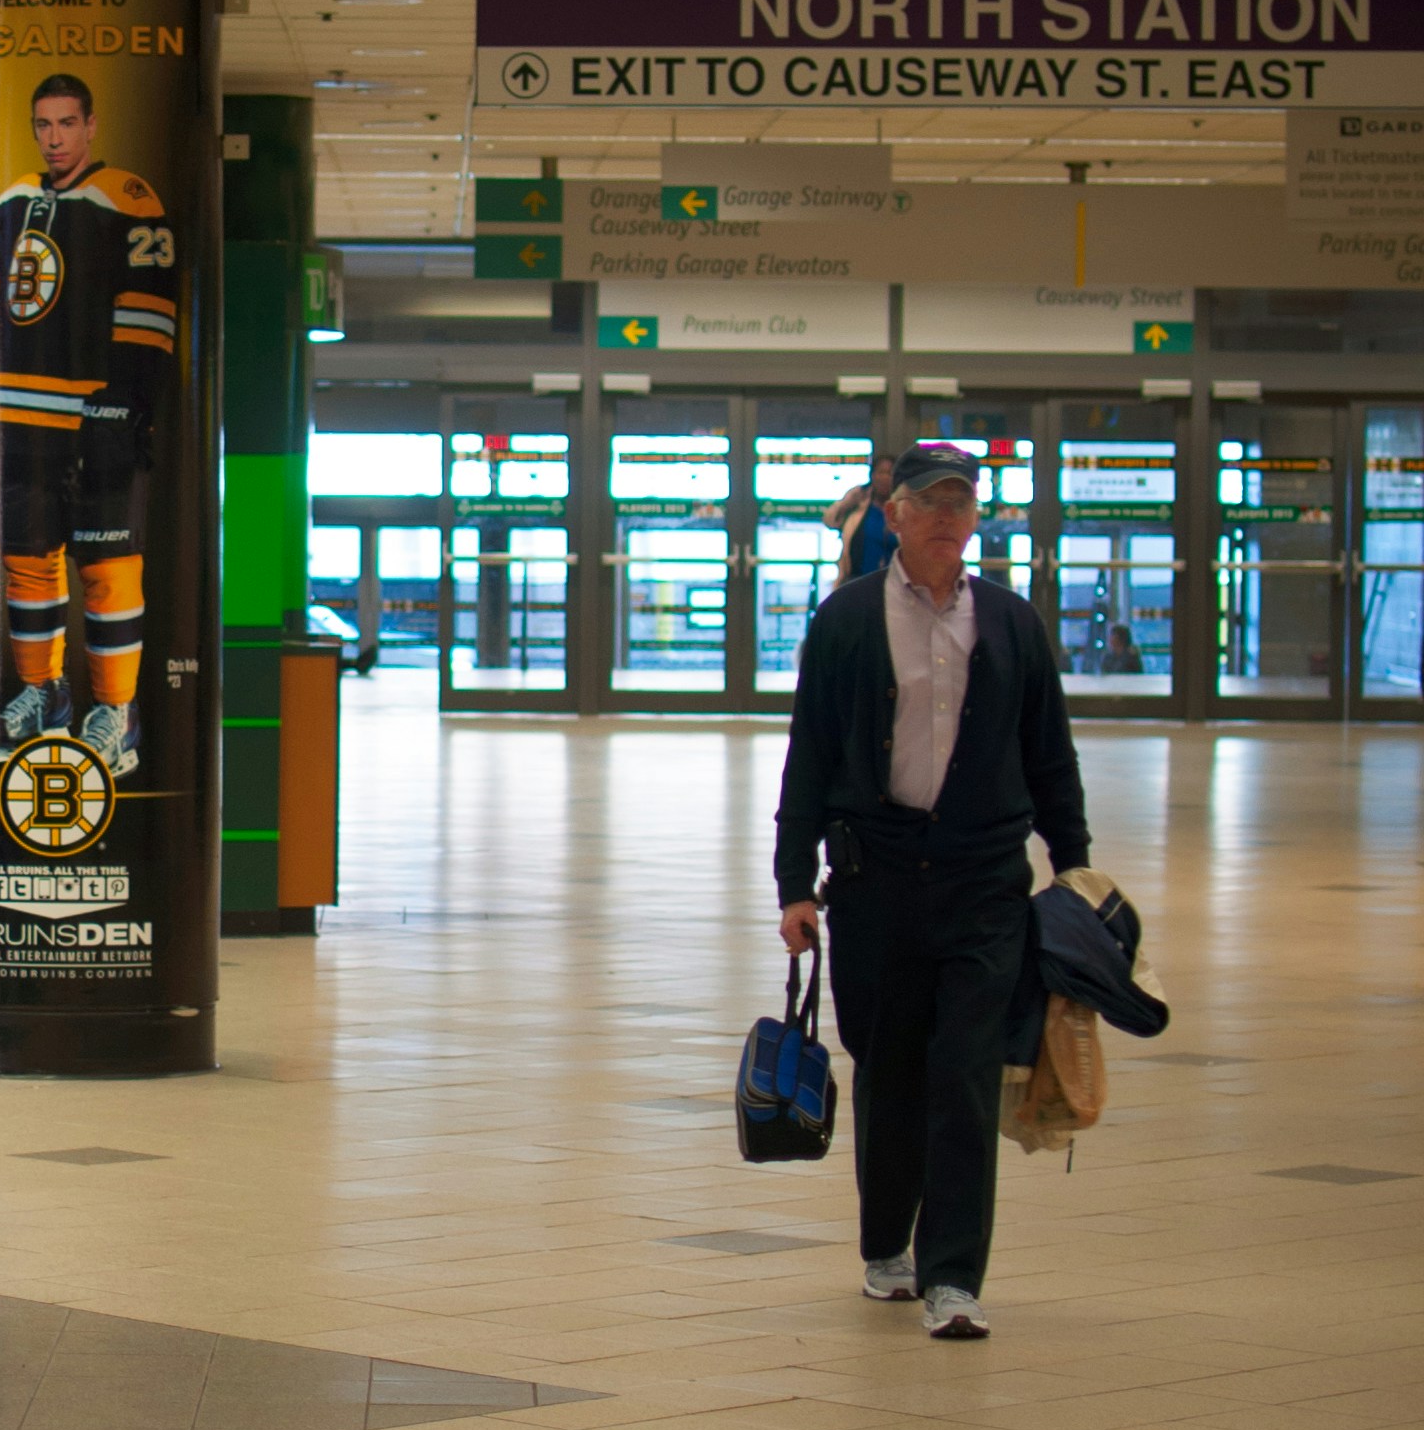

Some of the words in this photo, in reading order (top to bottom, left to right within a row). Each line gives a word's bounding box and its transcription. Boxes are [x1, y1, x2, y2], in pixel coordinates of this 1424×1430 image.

[571, 56, 686, 98] EXIT
[696, 56, 766, 99] TO
[783, 57, 1078, 100] CAUSEWAY
[1095, 58, 1170, 100] ST.
[1187, 59, 1326, 101] EAST
[590, 187, 662, 215] Orange
[723, 185, 792, 210] Garage
[800, 185, 887, 212] Stairway
[590, 213, 692, 238] Causeway
[128, 226, 176, 267] 23
[1318, 232, 1396, 259] Parking
[590, 252, 668, 278] Parking
[676, 253, 749, 278] Garage
[756, 253, 851, 277] Elevators
[1035, 285, 1123, 309] Causeway
[1130, 285, 1183, 306] Street
[683, 316, 762, 335] Premium
[768, 314, 807, 336] Club
[82, 403, 129, 420] AUER
[8, 865, 53, 876] BRUINS.
[54, 866, 75, 876] ALL
[76, 866, 98, 876] THE
[100, 865, 130, 876] TIME.
[6, 949, 97, 962] ENTERTAINMENT
[102, 949, 153, 962] NETWORK
